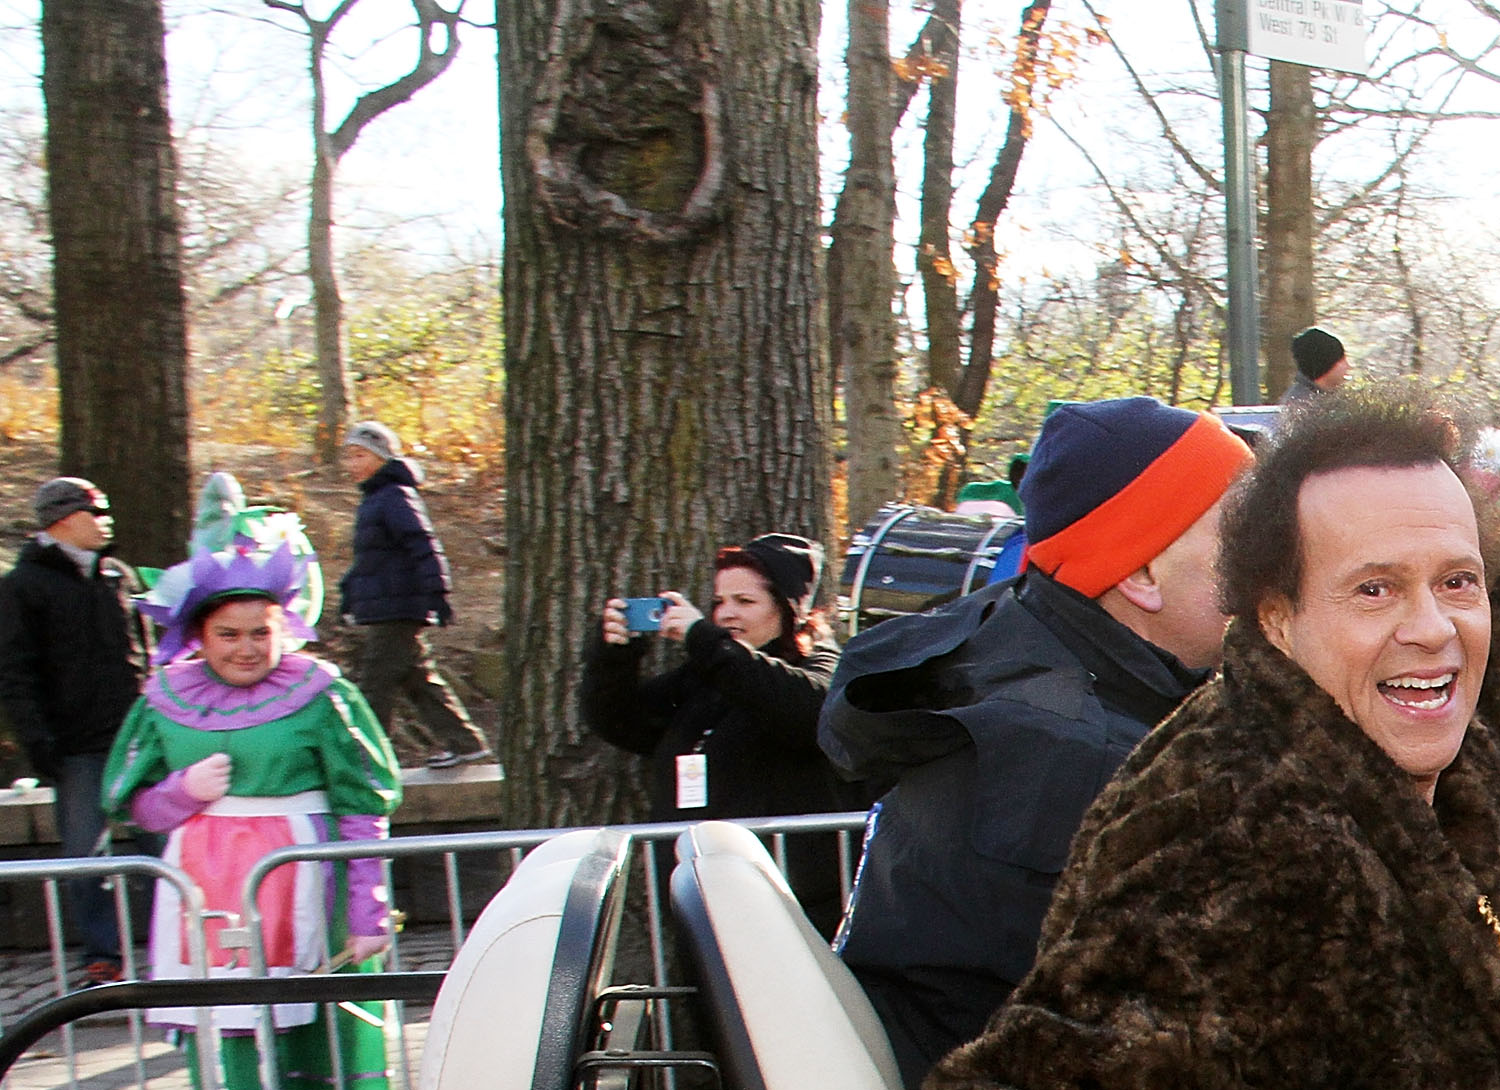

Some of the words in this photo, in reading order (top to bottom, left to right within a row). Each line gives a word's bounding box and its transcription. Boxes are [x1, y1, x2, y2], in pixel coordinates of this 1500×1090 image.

[1313, 0, 1327, 19] Pk
[1335, 5, 1346, 22] W
[1259, 13, 1293, 35] West
[1298, 20, 1316, 40] 79
[1323, 25, 1337, 44] St
